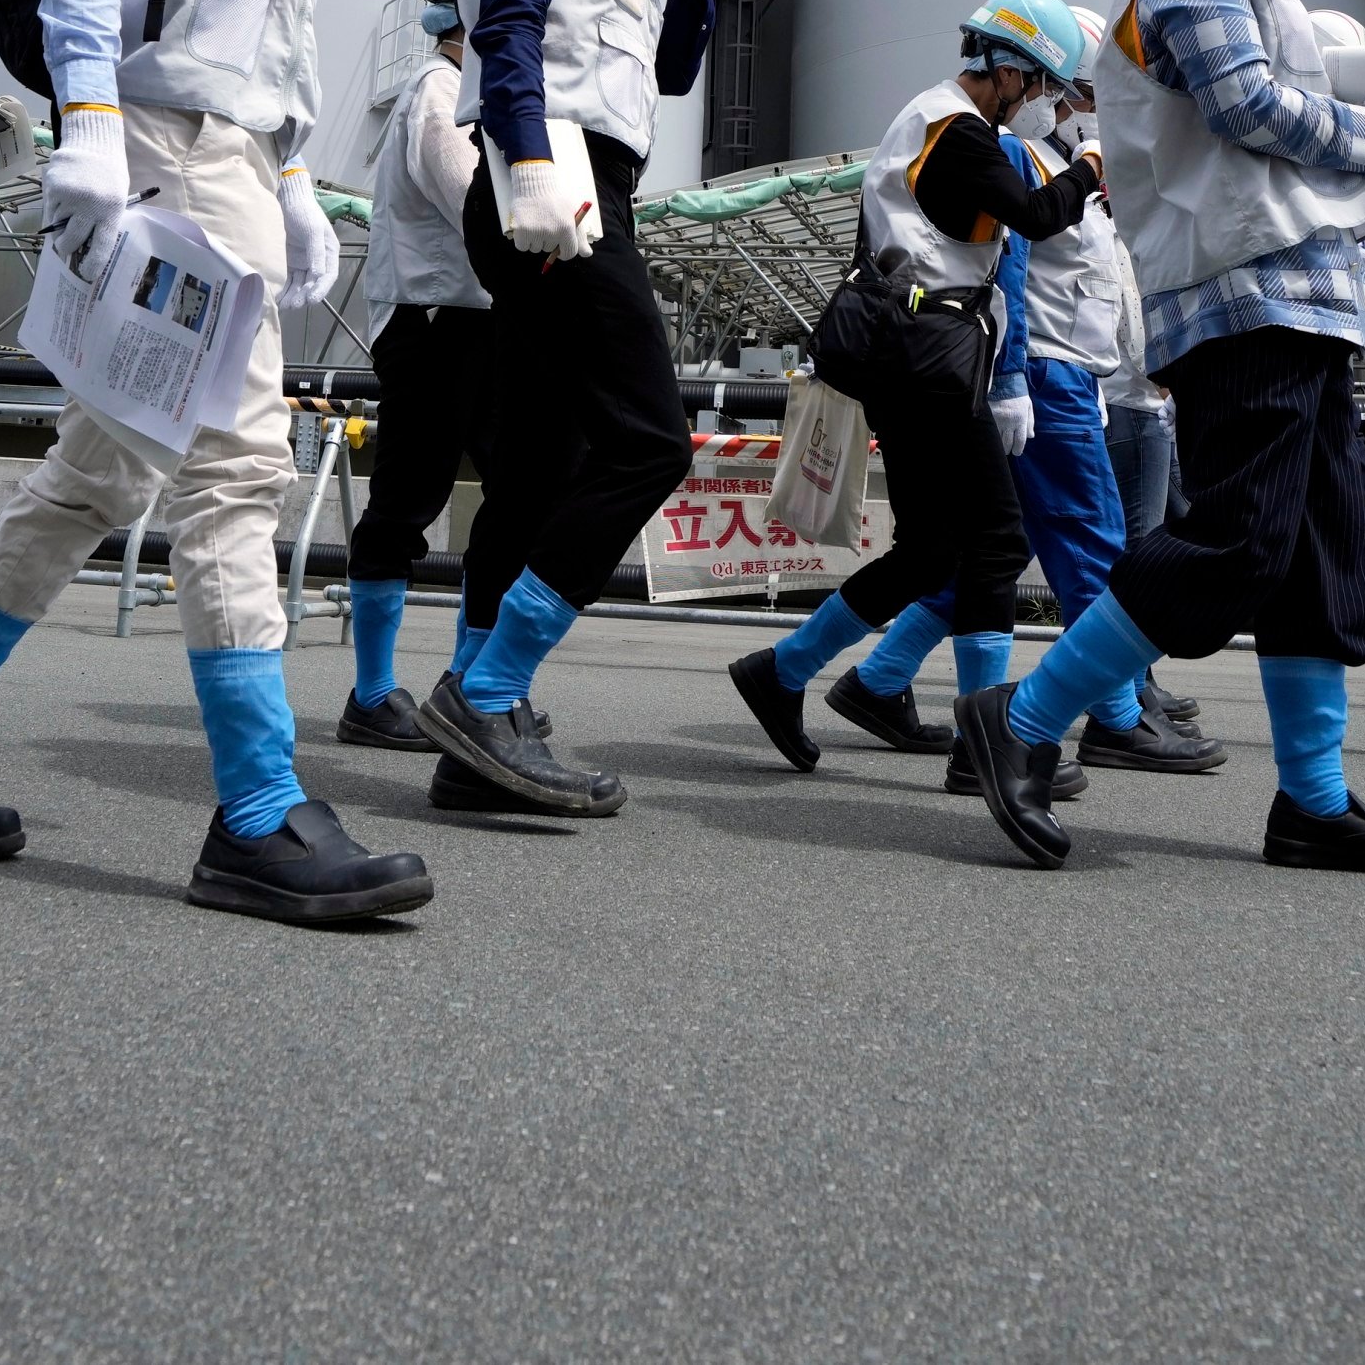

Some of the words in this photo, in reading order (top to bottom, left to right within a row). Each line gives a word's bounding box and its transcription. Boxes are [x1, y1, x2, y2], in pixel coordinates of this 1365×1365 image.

[806, 446, 835, 468] HIROHIMA
[712, 561, 733, 577] Q'd
[741, 557, 824, 576] 東京エネシス
